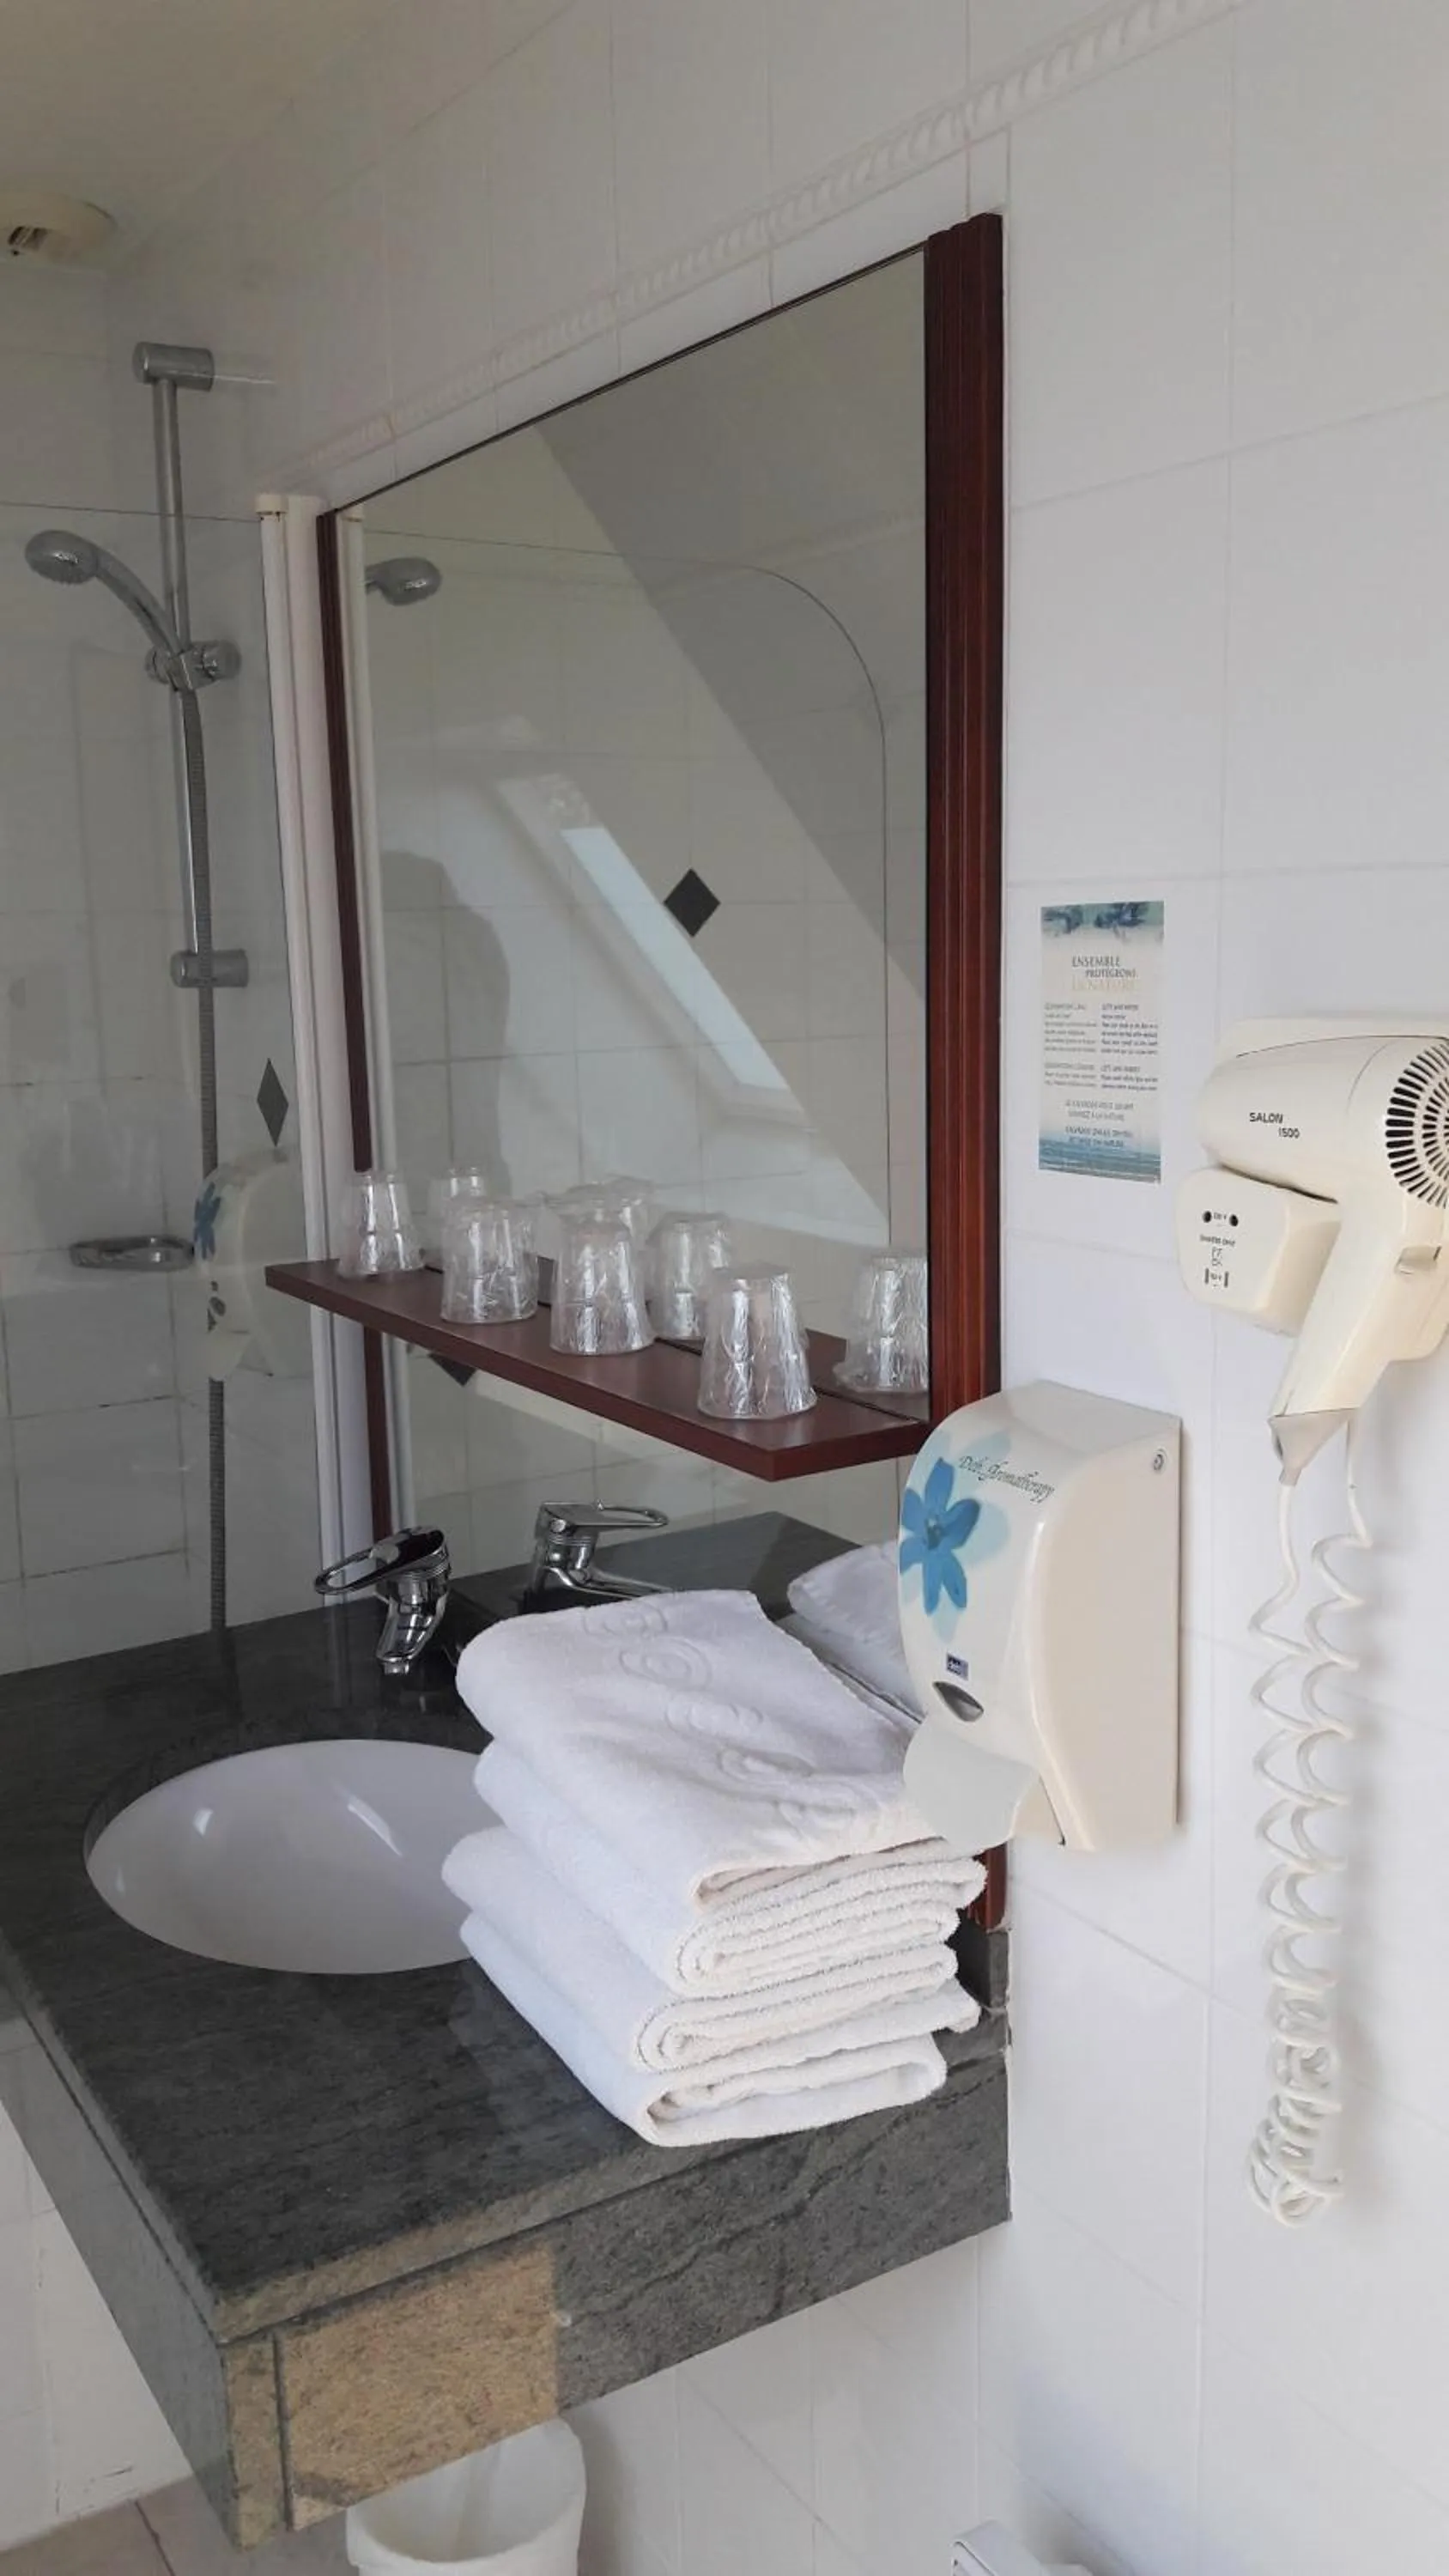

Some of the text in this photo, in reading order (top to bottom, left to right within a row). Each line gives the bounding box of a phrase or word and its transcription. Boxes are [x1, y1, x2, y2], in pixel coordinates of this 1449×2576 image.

[1071, 955, 1120, 968] ENSEMBLE
[1249, 1112, 1283, 1124] SALON
[1278, 1127, 1300, 1139] 1500
